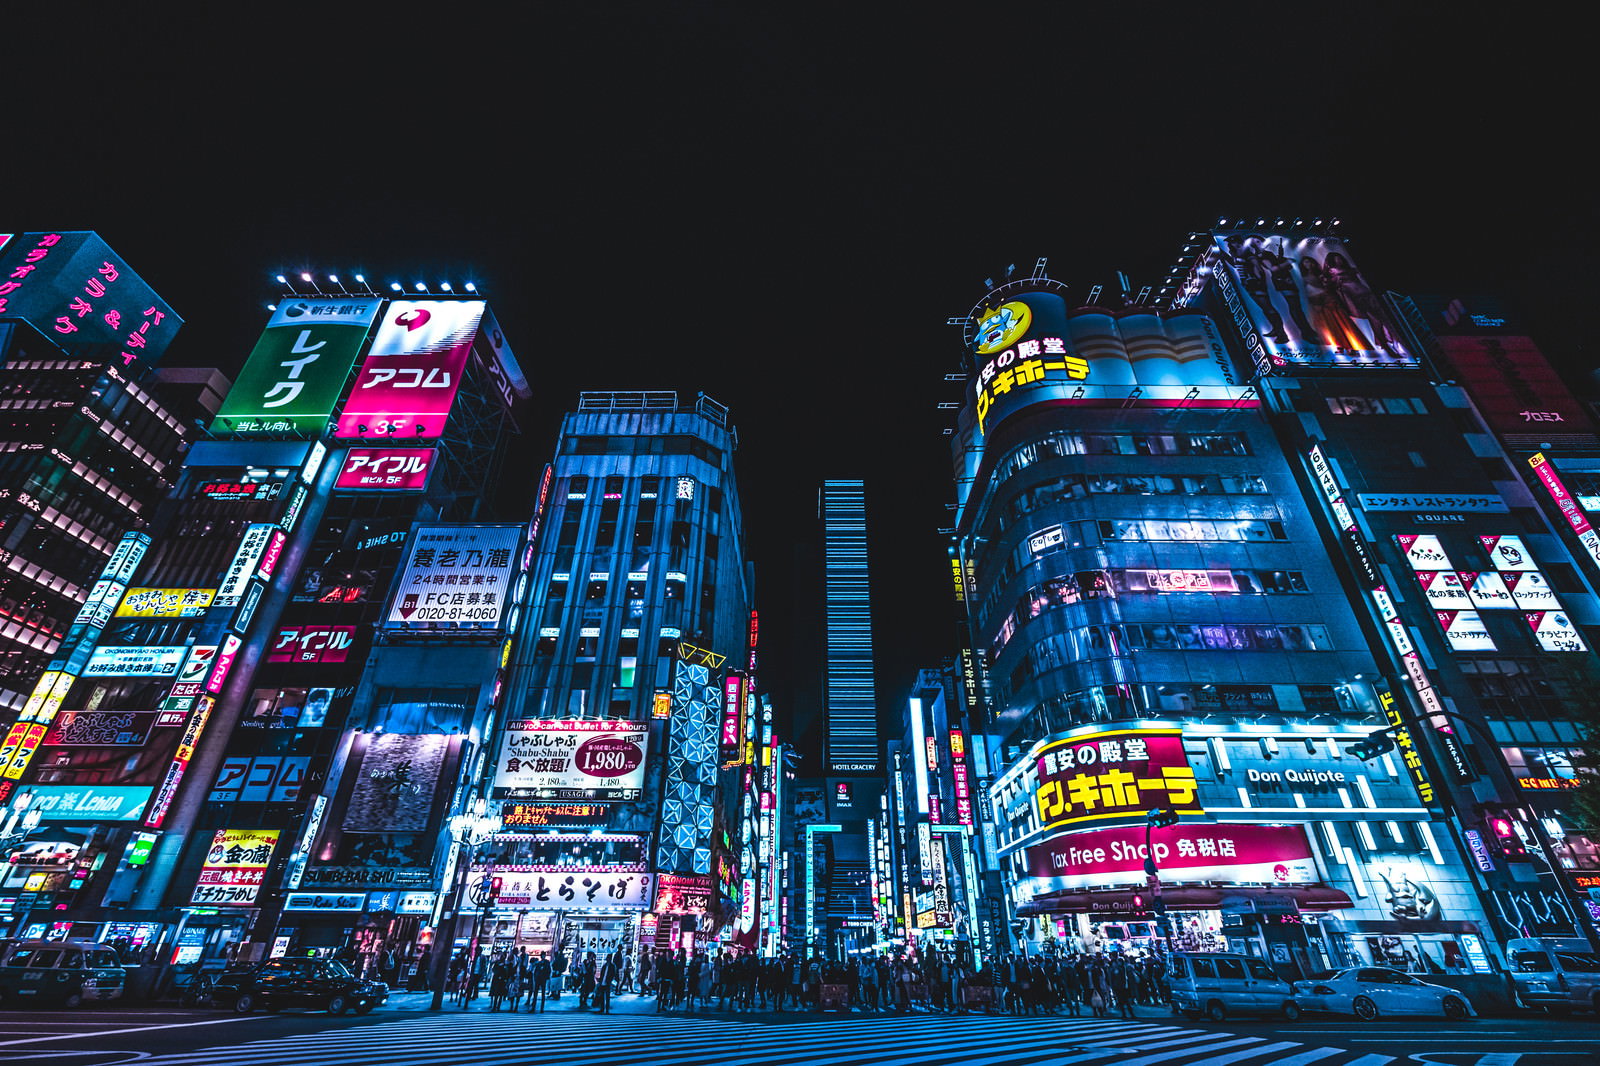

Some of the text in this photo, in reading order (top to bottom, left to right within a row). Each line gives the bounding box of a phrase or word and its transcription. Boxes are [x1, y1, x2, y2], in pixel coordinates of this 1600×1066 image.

[54, 261, 119, 335] カラオケ
[311, 304, 368, 316] 新生銀行
[103, 309, 121, 330] &
[120, 306, 165, 365] パーティ
[262, 329, 327, 408] レイク
[362, 368, 451, 389] アコム
[489, 356, 513, 408] アコム
[1520, 411, 1564, 422] プロミス
[375, 419, 406, 435] 3F
[346, 456, 427, 474] アイフル
[386, 476, 402, 484] 5F
[1367, 498, 1501, 507] エンタメ レストランタワー
[1400, 536, 1413, 544] 8F
[1482, 537, 1495, 545] 9F
[414, 549, 511, 568] 養老乃瀧
[413, 575, 498, 585] 24時間営業中
[1418, 573, 1431, 581] 4F
[1461, 573, 1473, 582] 5F
[1503, 574, 1516, 582] 6F
[126, 590, 209, 604] お好み 焼き
[425, 593, 497, 605] FC店募集
[1428, 589, 1468, 598] 北の家族
[417, 608, 497, 619] 0120-81-4060
[1438, 613, 1450, 621] B1
[1527, 613, 1540, 621] 2F
[302, 652, 316, 660] 5F
[89, 664, 153, 673] お好み焼き本陣
[61, 713, 136, 728] しゃぶしゃぶ
[509, 734, 577, 747] しゃぶしゃぶ
[178, 748, 189, 757] 2F
[1045, 739, 1150, 776] 驚安の殿堂
[583, 752, 625, 771] 1,980
[217, 764, 304, 786] アコム
[1248, 769, 1345, 785] Don Quijote
[623, 790, 639, 799] 5F
[224, 844, 271, 863] 金の蔵
[1176, 839, 1237, 857] 免税店
[1051, 840, 1169, 870] Tax Free Shop
[222, 871, 263, 883] 焼き牛丼
[203, 886, 256, 901] チカラめし
[536, 876, 633, 902] とらそば
[1093, 903, 1109, 911] Don
[983, 920, 992, 950] カラオケ
[580, 938, 619, 949] とらそば
